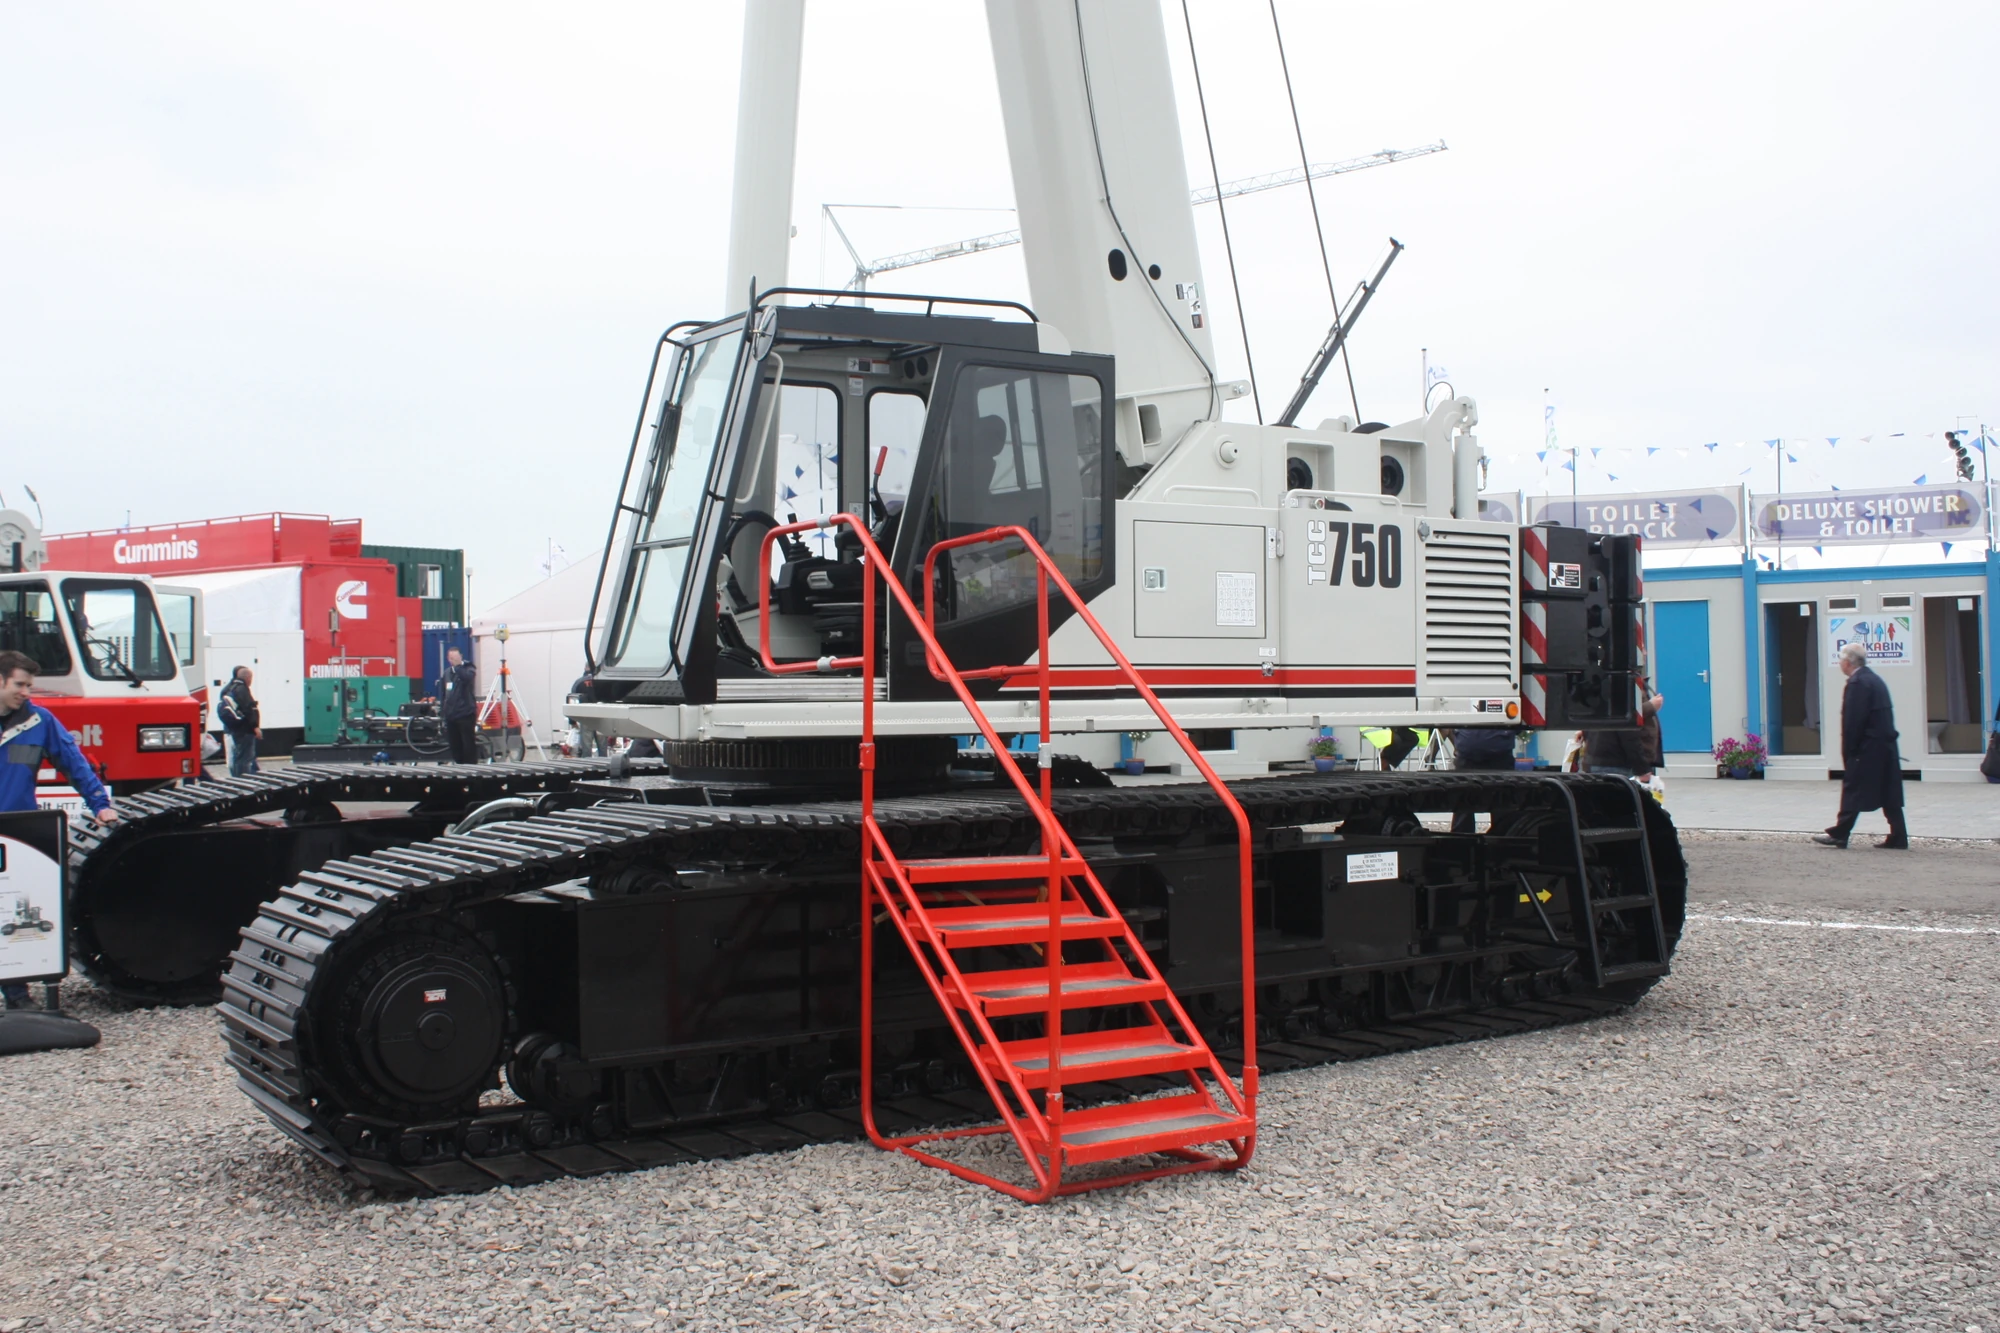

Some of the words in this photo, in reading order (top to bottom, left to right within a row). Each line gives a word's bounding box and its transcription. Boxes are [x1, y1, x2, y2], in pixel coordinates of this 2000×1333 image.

[1586, 503, 1677, 522] TOILET
[1776, 501, 1856, 521] DELUXE
[1864, 495, 1960, 517] SHOWER
[1819, 521, 1835, 537] &
[1844, 517, 1916, 536] TOILET
[113, 534, 198, 564] Cummins
[1307, 520, 1326, 585] TCC
[1329, 521, 1401, 588] 750
[311, 664, 360, 678] CUMMNS
